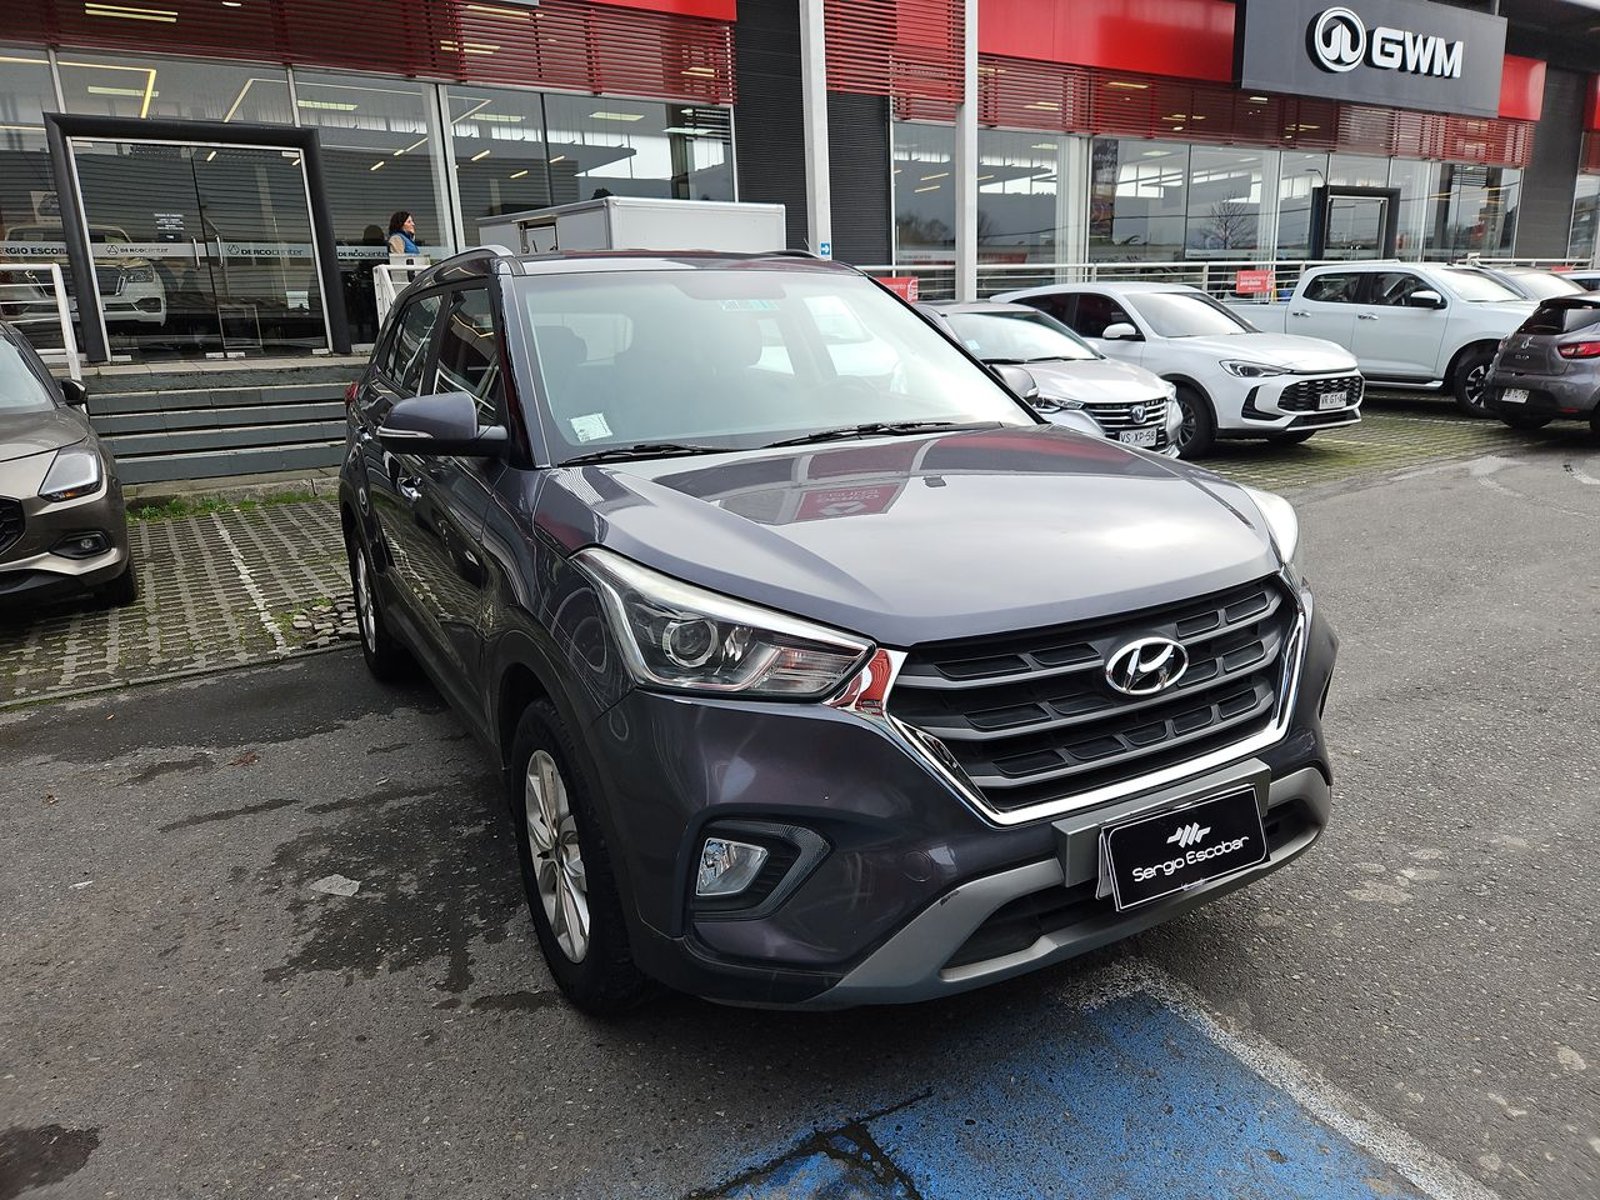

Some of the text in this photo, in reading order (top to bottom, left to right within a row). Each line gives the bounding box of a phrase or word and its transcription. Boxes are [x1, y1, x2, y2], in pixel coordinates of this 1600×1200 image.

[1371, 26, 1464, 78] GWM
[1132, 836, 1250, 882] Sergio Escobar
